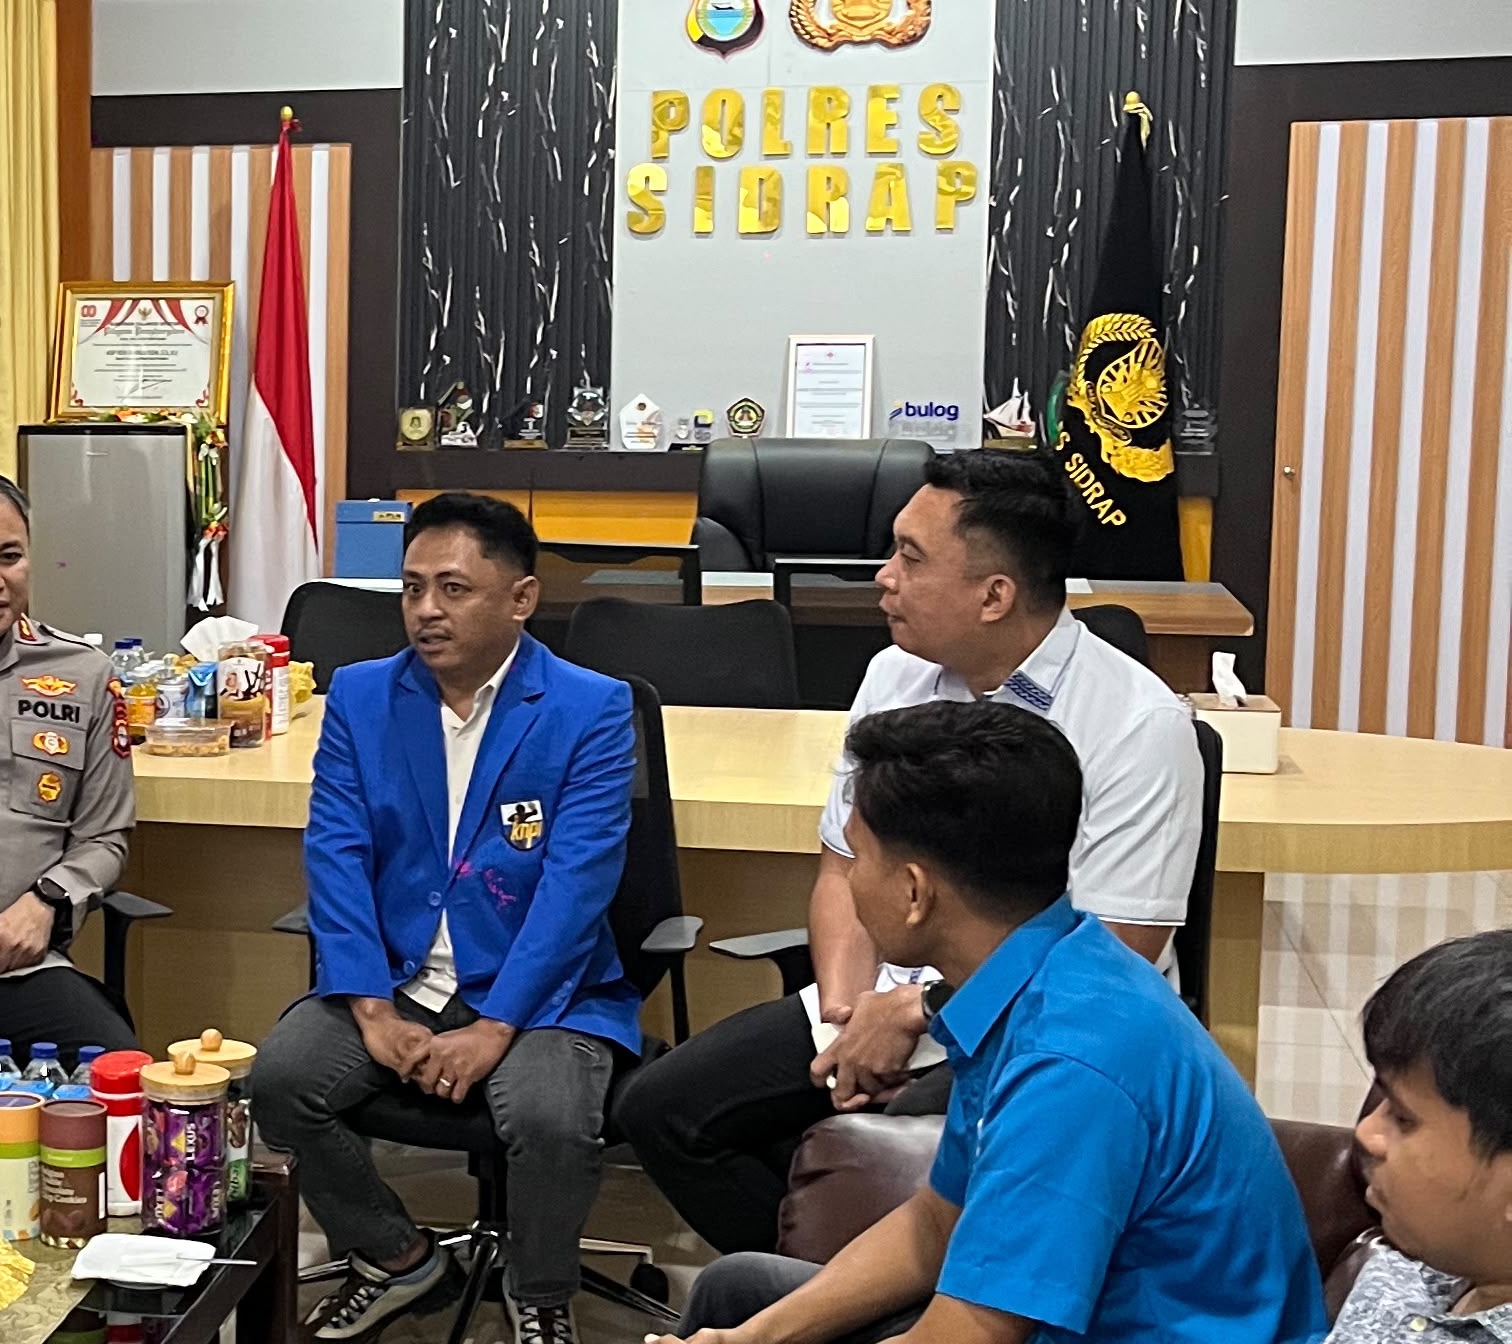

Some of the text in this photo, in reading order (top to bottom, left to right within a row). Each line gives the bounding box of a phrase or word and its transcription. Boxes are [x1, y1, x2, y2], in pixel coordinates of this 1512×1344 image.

[650, 83, 962, 159] POLRES
[626, 160, 977, 234] SIDRAP
[905, 402, 959, 421] bulog
[1065, 453, 1127, 526] SIDRAP
[18, 699, 81, 723] POLRI
[186, 1122, 196, 1161] LEXUS
